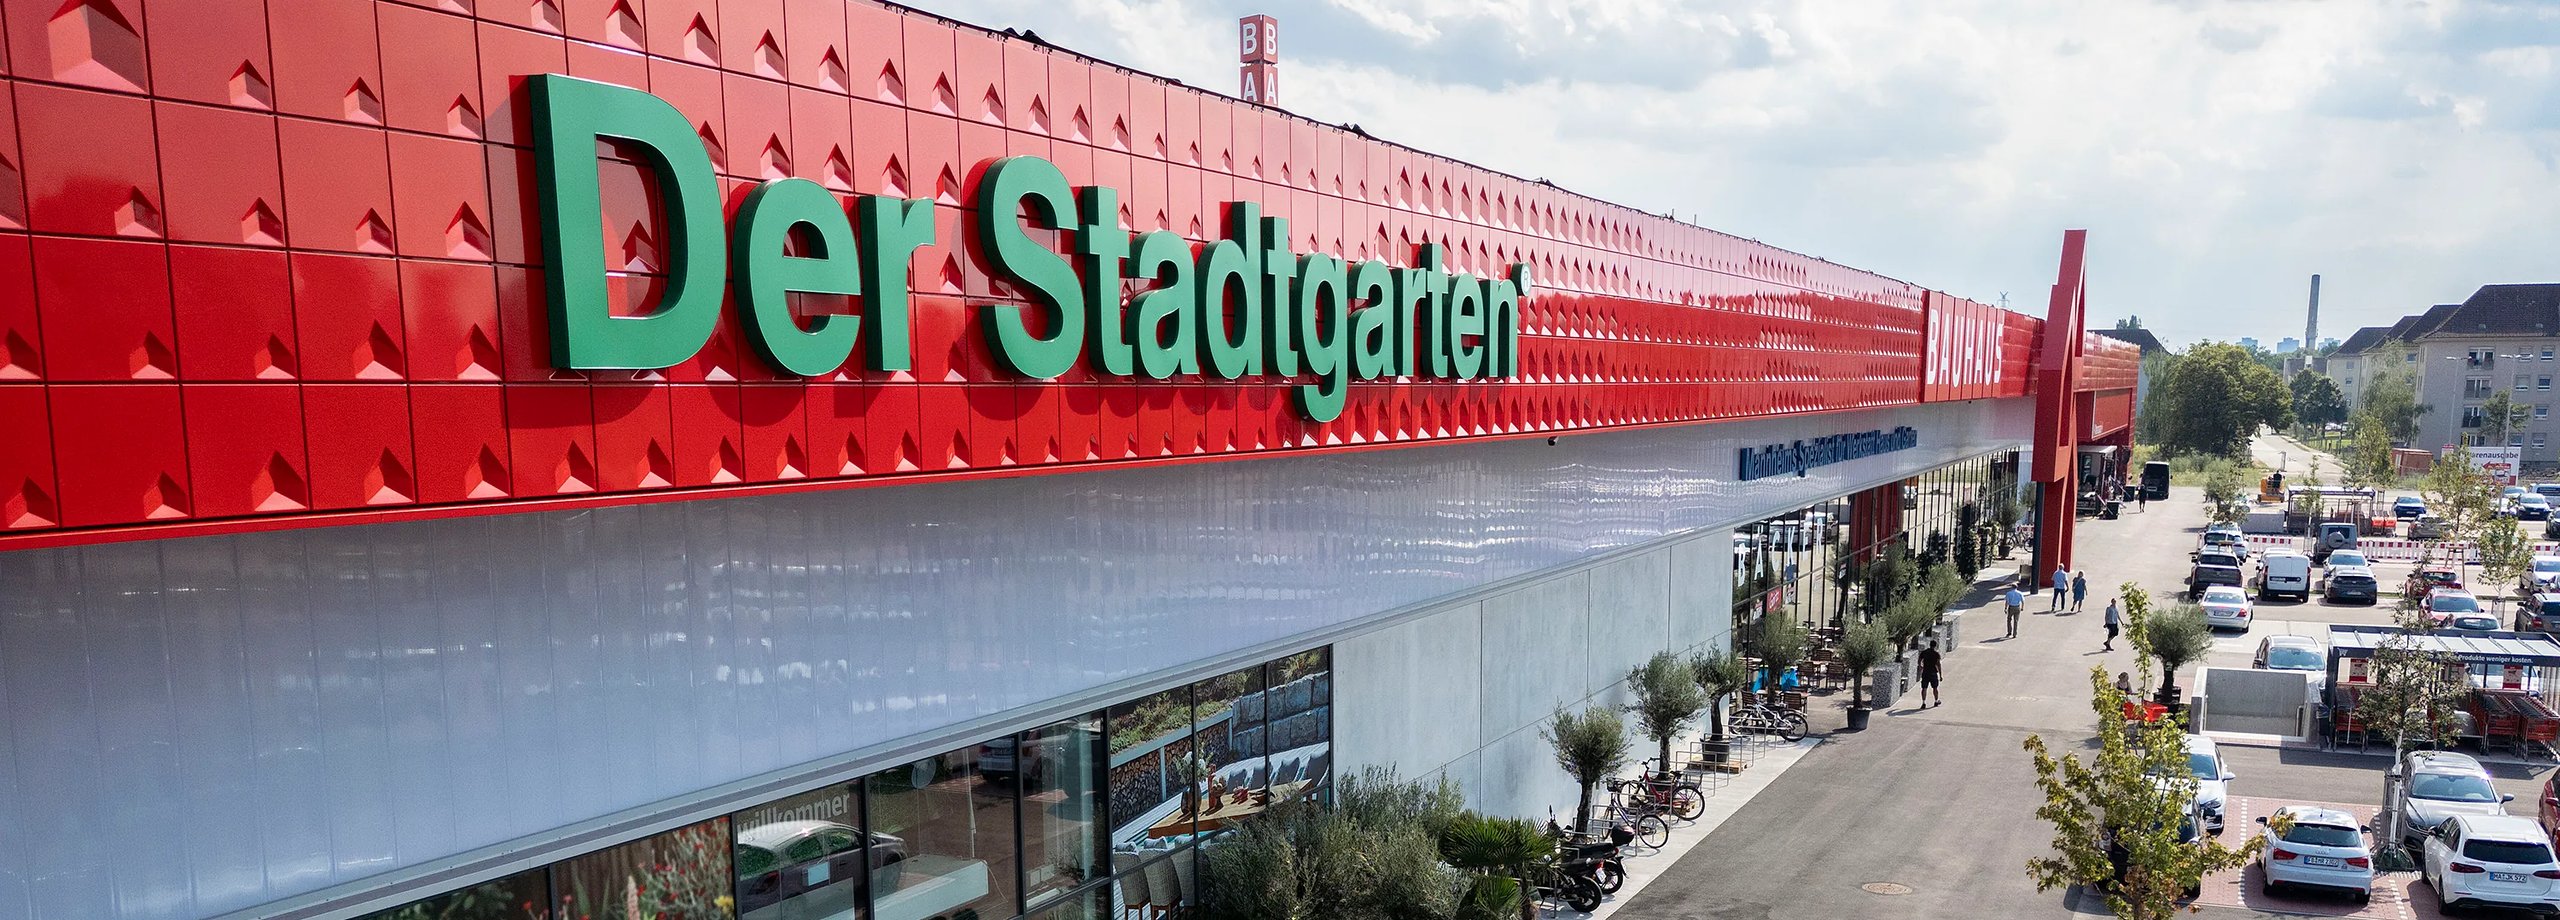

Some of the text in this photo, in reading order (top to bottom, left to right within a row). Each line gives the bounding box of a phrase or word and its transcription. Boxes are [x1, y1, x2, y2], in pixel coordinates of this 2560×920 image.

[530, 71, 935, 376] Der
[1927, 308, 2004, 387] BAUHAUS
[1741, 444, 1798, 481] Mannheims
[1797, 437, 1834, 478] Spezialist
[1738, 518, 1823, 587] BÄCKER
[2458, 654, 2486, 662] Produkte
[2486, 656, 2511, 664] weniger
[2511, 656, 2533, 664] kosten.
